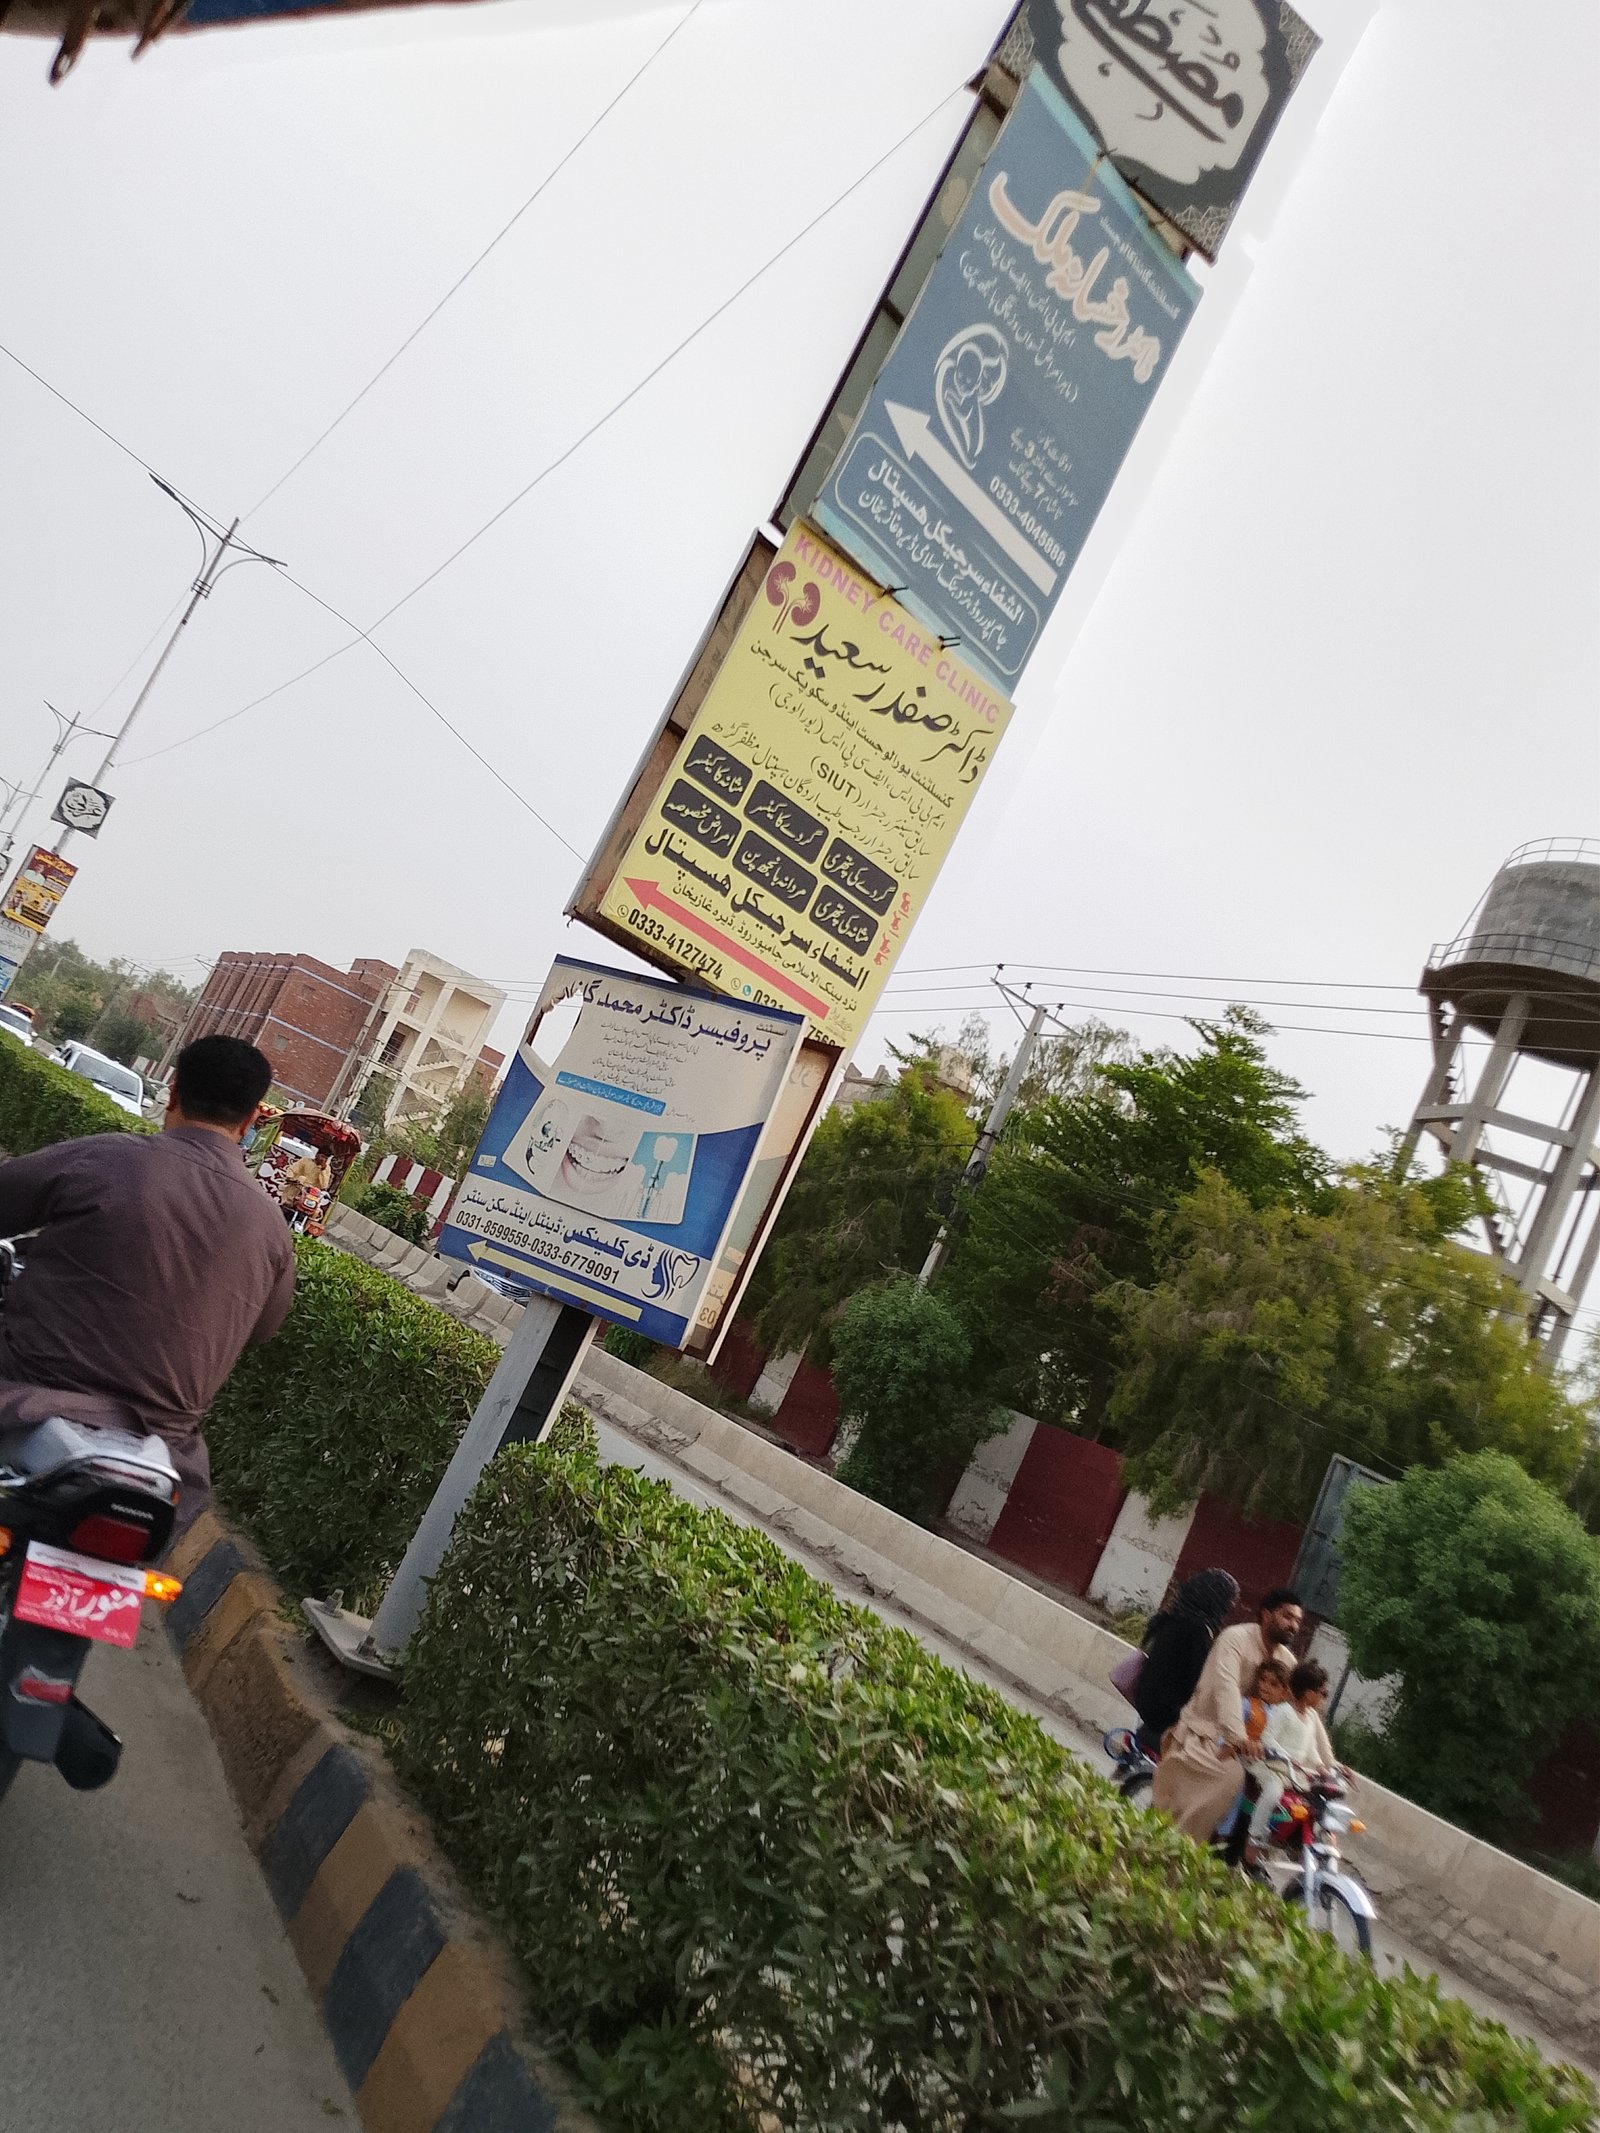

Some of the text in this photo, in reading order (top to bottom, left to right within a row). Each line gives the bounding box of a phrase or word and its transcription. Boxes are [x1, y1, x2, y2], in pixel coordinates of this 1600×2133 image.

[1024, 440, 1035, 459] 3
[1034, 482, 1045, 499] 7
[794, 534, 999, 723] KIDNEY CARE CLINIC
[750, 640, 787, 672] سرجن
[791, 624, 993, 783] ڈاکٹر صفدر سعید
[819, 731, 845, 750] ایس
[841, 743, 856, 768] پی
[852, 758, 869, 772] سی
[686, 753, 743, 792] مثانہ کا کینسر
[863, 759, 889, 786] ایف
[910, 771, 954, 808] کنسلٹنٹ
[908, 797, 923, 820] بی
[918, 805, 933, 827] بی
[926, 813, 945, 830] ایم
[666, 803, 735, 846] امراض مخصوصہ
[749, 800, 823, 845] گردے کا کینسر
[904, 829, 930, 856] سابق
[741, 850, 806, 898] مردانہ بانجھ پن
[823, 853, 896, 901] گردے کی پتھری
[893, 853, 919, 879] سابق
[712, 909, 735, 926] ڈیرہ
[730, 888, 812, 953] سرجیکل
[815, 902, 869, 942] مثانہ کی پتھری
[628, 909, 722, 978] 0333-4127474
[810, 942, 869, 990] الشفاء
[596, 995, 643, 1014] محمد
[818, 981, 842, 1004] بینک
[841, 998, 857, 1011] نزد
[640, 999, 695, 1029] ڈاکٹر
[689, 1020, 771, 1060] پروفیسر
[461, 1189, 487, 1206] سنٹر
[485, 1198, 509, 1214] سکن
[509, 1202, 531, 1221] اینڈ
[528, 1213, 563, 1234] ڈینٹل
[623, 1243, 654, 1268] ڈی
